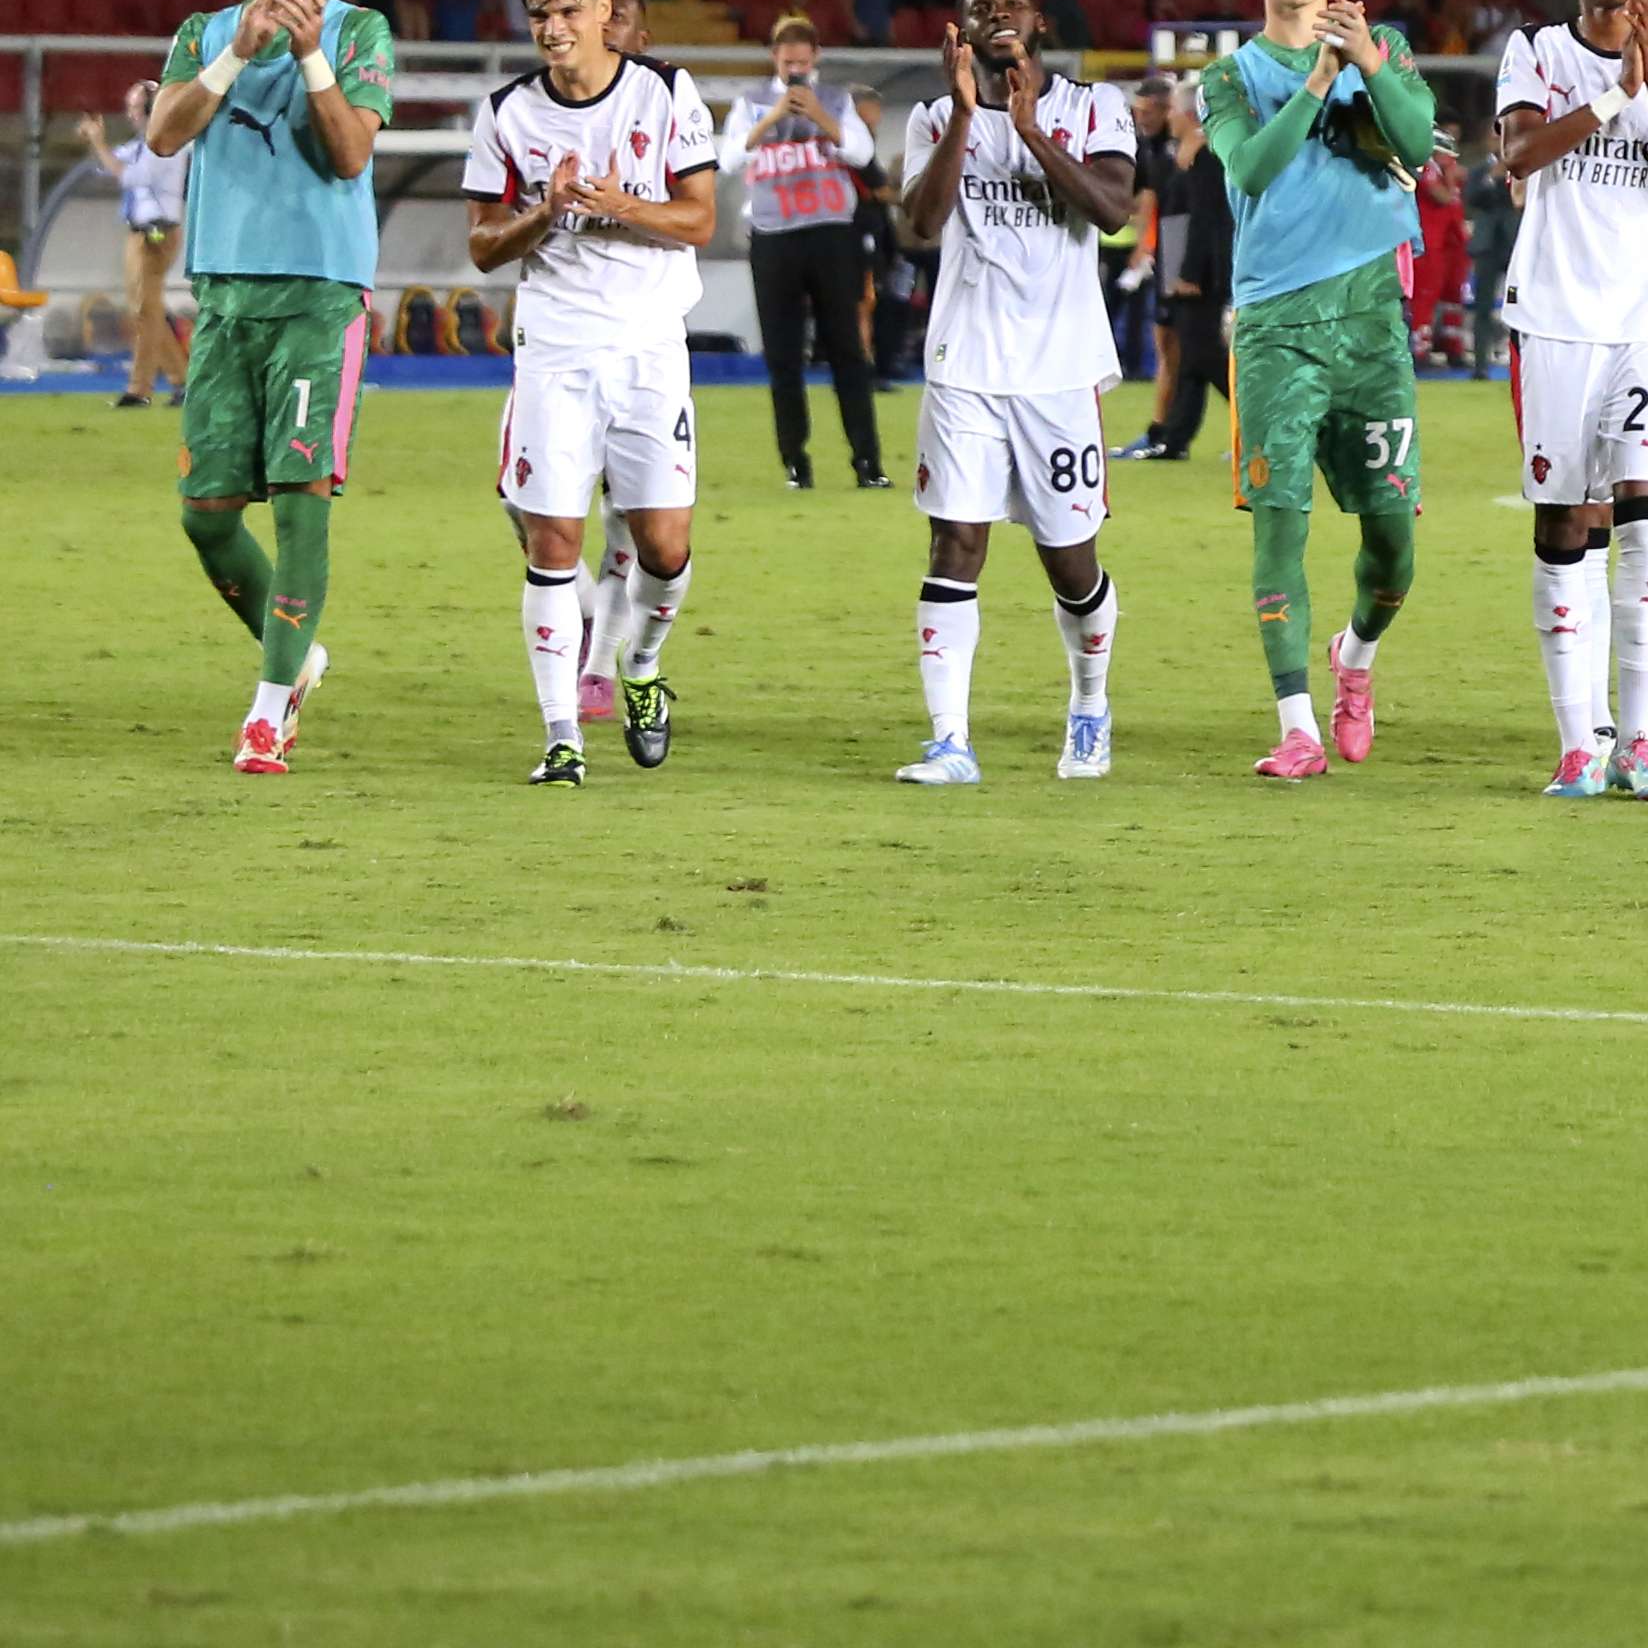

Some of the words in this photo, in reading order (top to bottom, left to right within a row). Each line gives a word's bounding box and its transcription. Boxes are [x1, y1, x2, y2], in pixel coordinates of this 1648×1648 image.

[1562, 158, 1587, 182] FLY
[1591, 162, 1648, 189] BETTER
[773, 178, 847, 220] 160
[983, 205, 1009, 227] FLY
[291, 378, 311, 428] 1
[673, 406, 691, 452] 4
[1364, 418, 1413, 469] 37
[1050, 443, 1100, 493] 80
